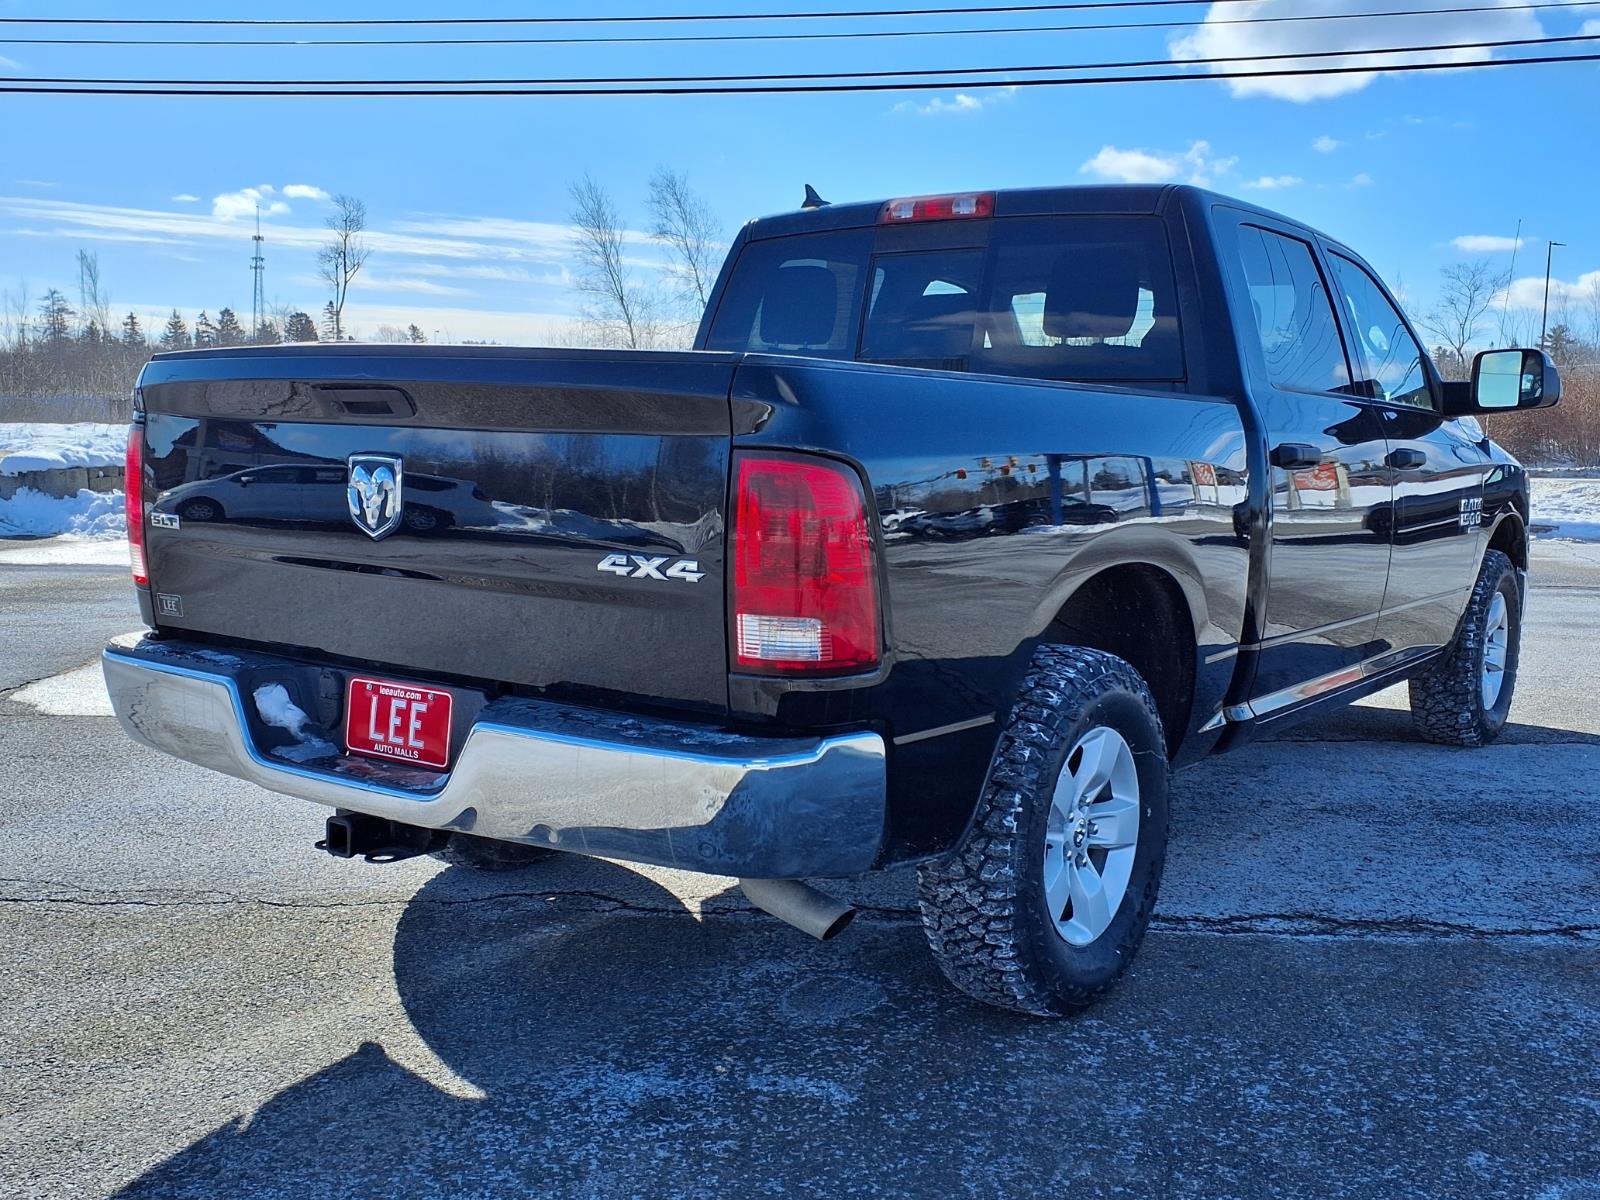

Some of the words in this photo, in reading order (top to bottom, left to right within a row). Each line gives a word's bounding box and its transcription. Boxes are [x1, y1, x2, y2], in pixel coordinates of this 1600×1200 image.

[152, 514, 178, 527] SLT
[163, 600, 177, 612] LEE
[379, 686, 422, 701] leeauto.com
[369, 694, 428, 749] LEE
[374, 743, 393, 754] AUTO
[394, 747, 419, 759] MALLS
